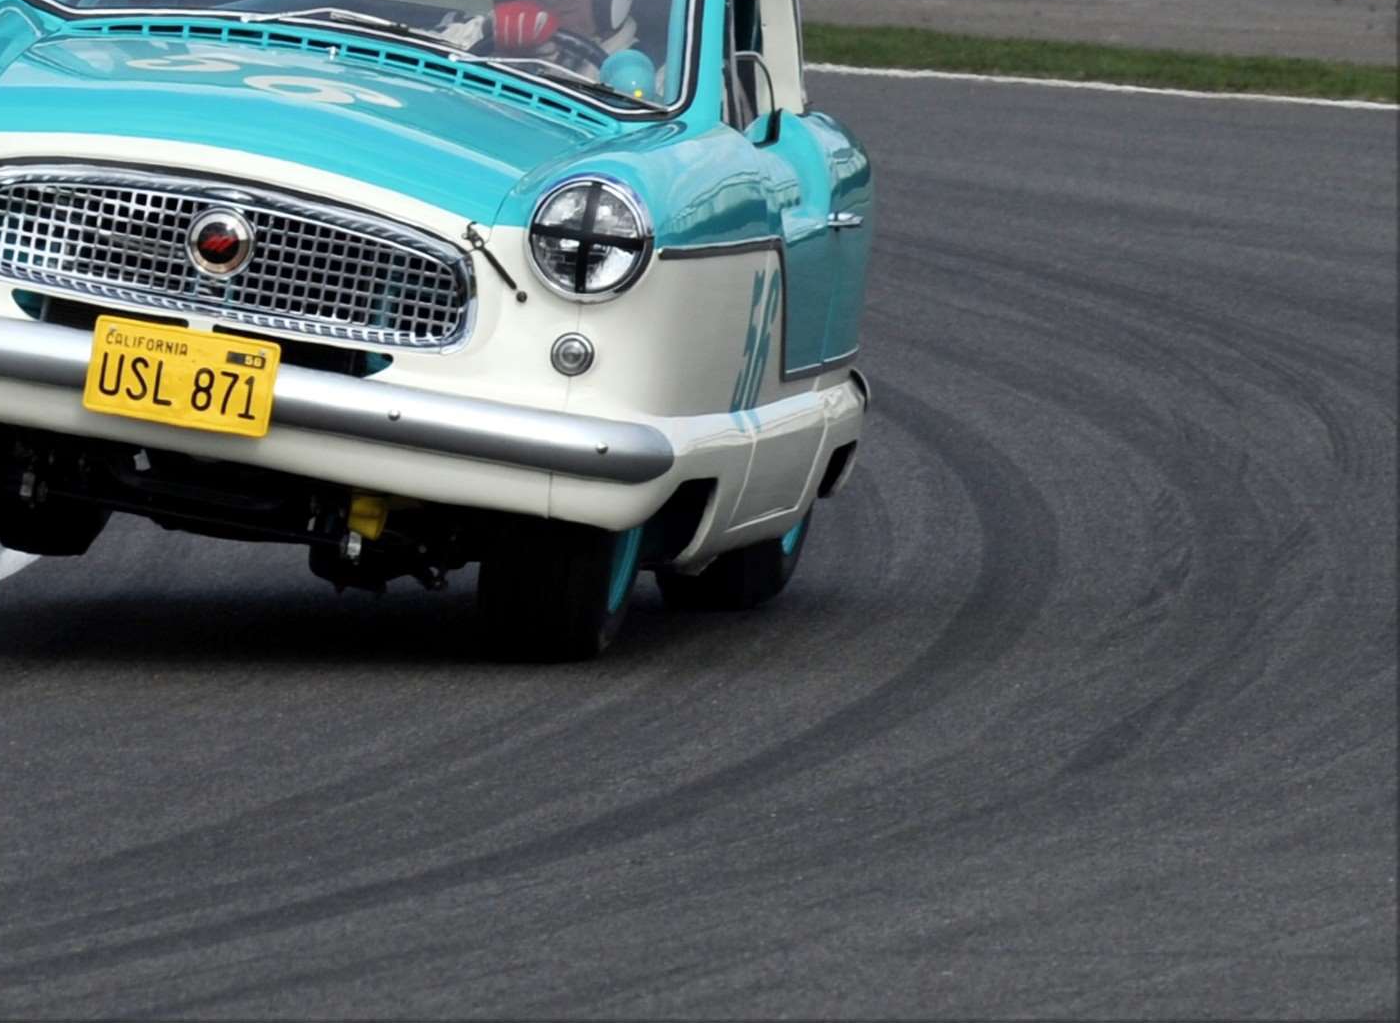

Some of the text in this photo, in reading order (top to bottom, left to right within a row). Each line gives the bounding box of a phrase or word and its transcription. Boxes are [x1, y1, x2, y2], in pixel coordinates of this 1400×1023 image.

[105, 331, 189, 357] CALIFORNIA
[98, 351, 256, 421] USL 871
